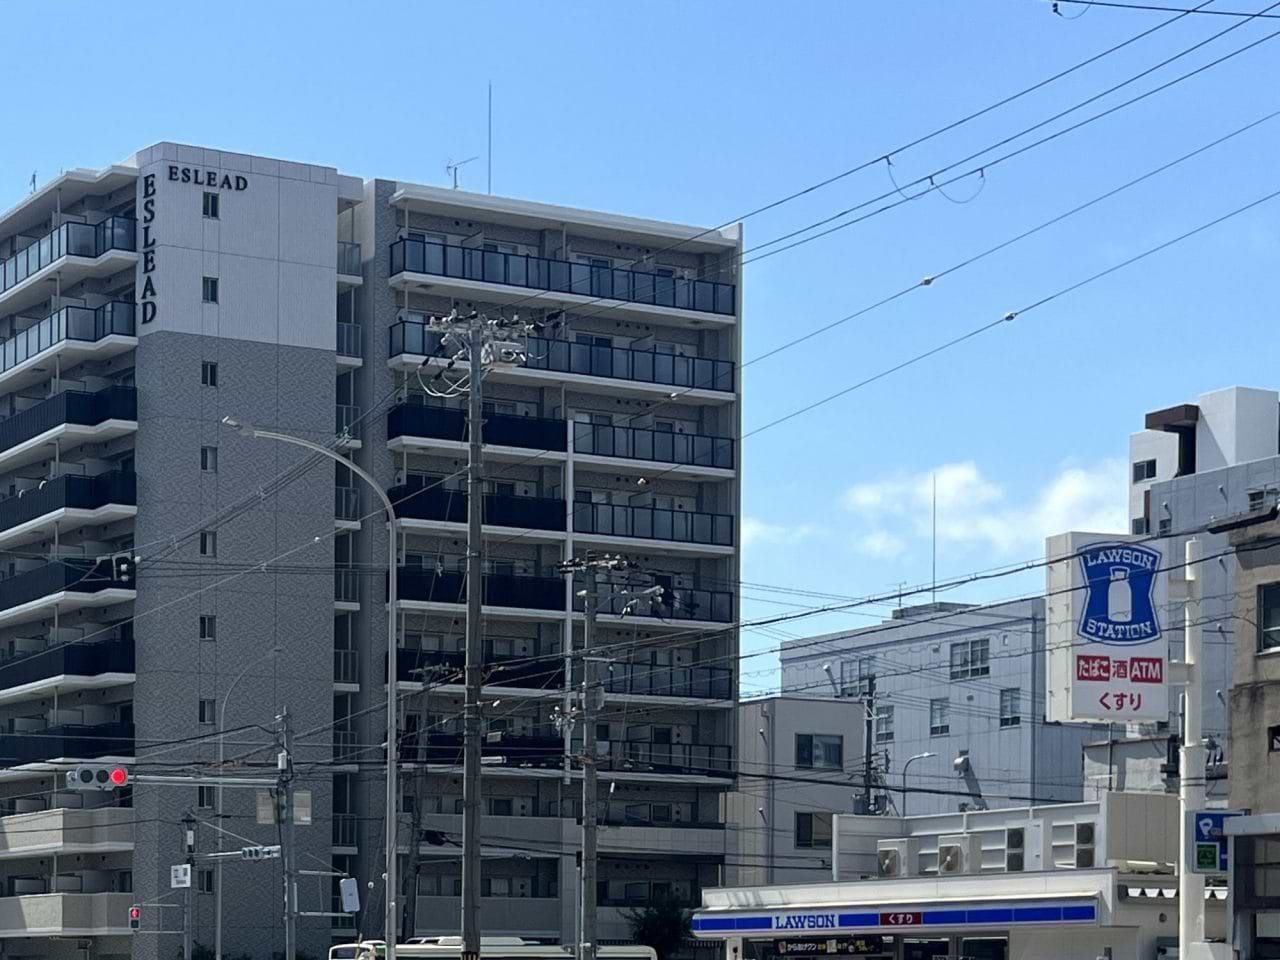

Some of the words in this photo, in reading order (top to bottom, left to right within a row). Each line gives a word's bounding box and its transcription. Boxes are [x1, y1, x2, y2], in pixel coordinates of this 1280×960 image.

[168, 165, 248, 191] ESLEAD
[141, 173, 157, 325] ESLEAD
[1087, 549, 1154, 570] LAWSON
[1086, 618, 1152, 639] STATION
[1078, 659, 1110, 677] たばこ
[1112, 660, 1128, 679] 酒
[1131, 663, 1161, 679] ATM
[1099, 692, 1142, 711] くすり
[775, 914, 836, 929] LAWSON
[889, 914, 913, 925] くすり
